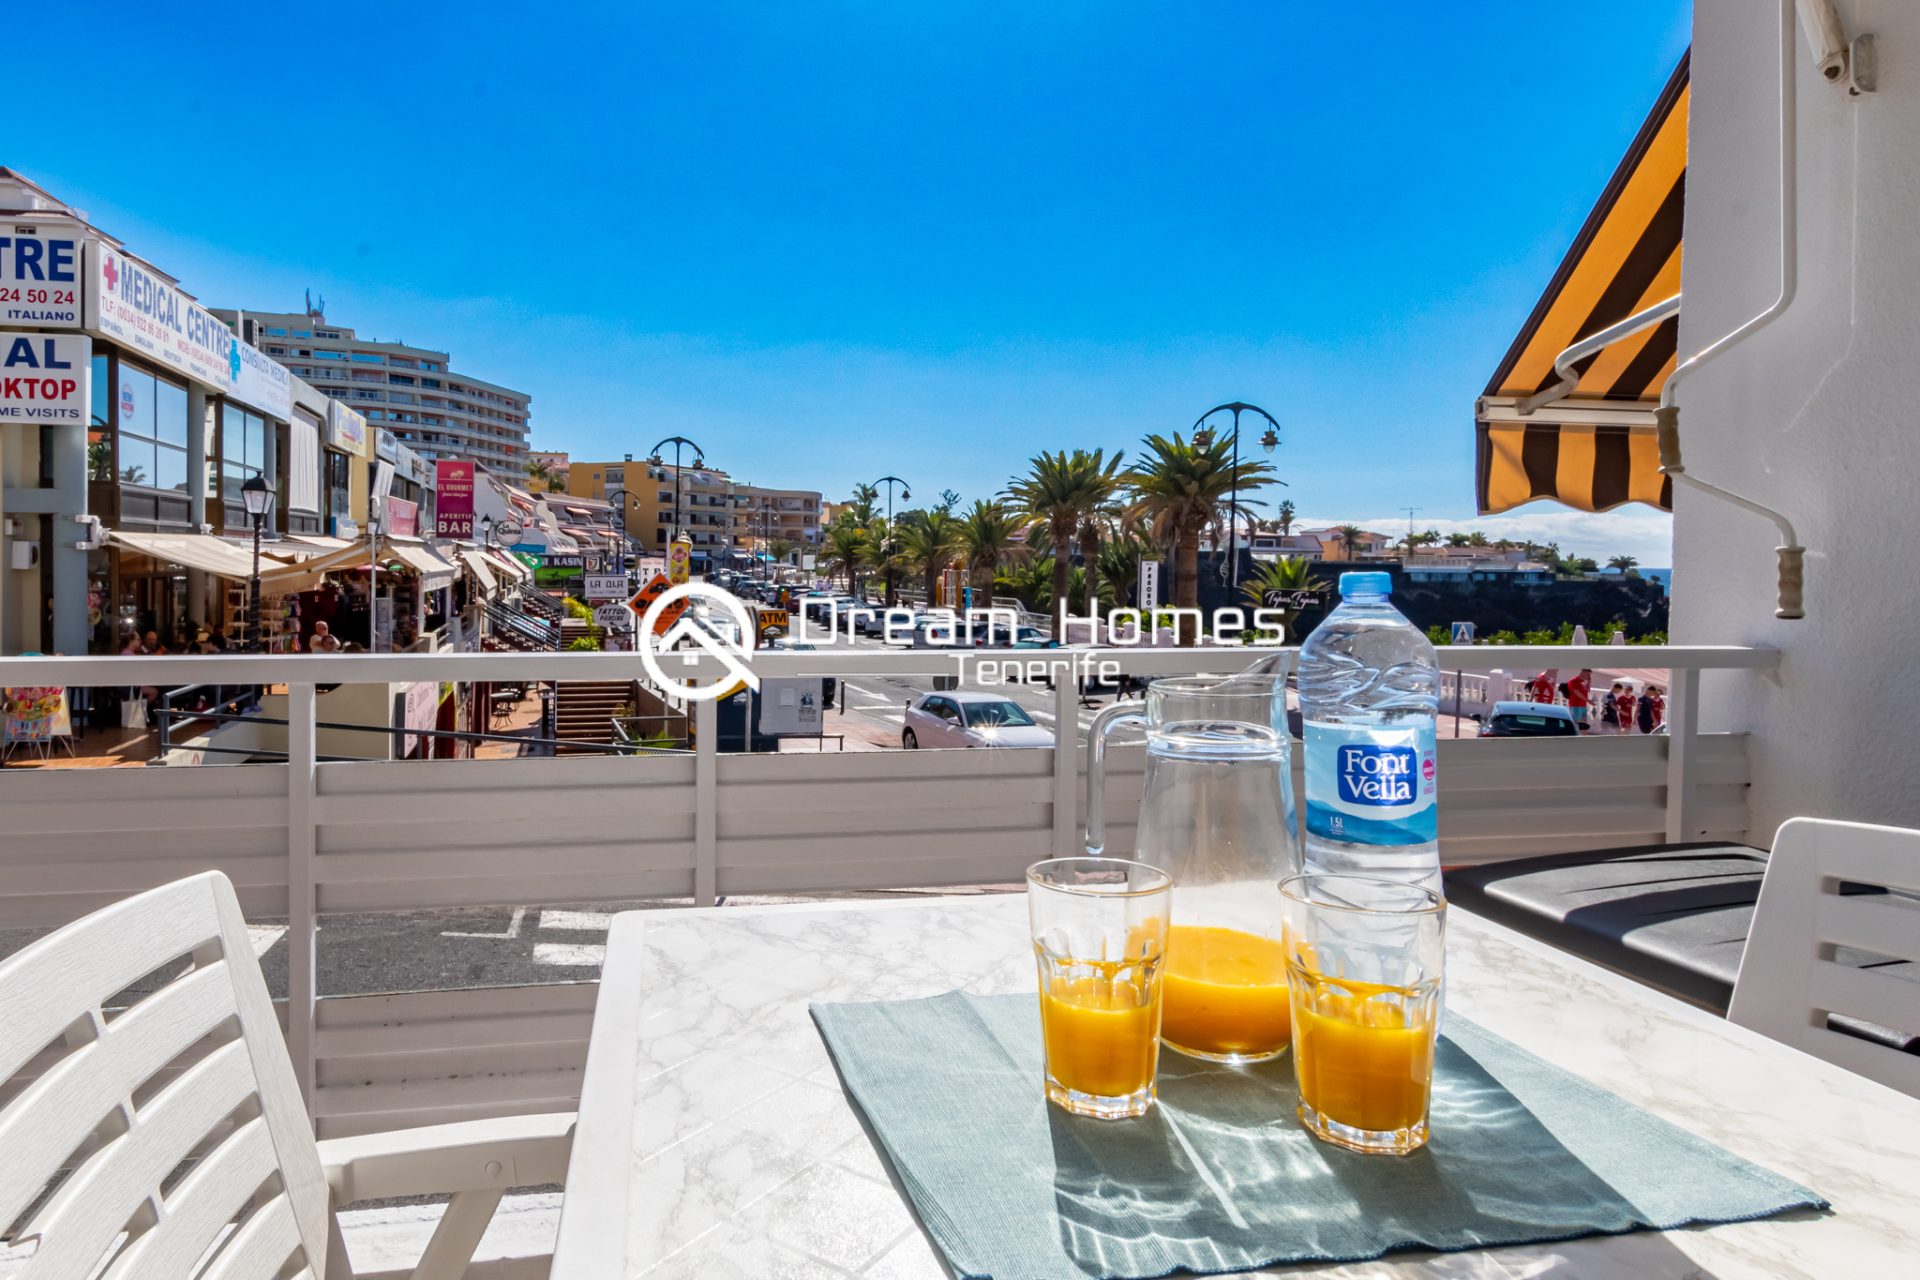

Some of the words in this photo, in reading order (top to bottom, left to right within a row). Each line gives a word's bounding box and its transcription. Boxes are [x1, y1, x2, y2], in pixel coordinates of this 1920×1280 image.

[0, 288, 20, 302] 24
[27, 289, 47, 303] 50
[54, 290, 75, 304] 24
[8, 310, 75, 321] ITALIANO
[121, 260, 182, 334] MEDICAL
[187, 305, 229, 361] CENTRE
[4, 337, 71, 369] AL
[0, 378, 76, 400] KTOP
[25, 408, 79, 418] VISITS
[438, 521, 471, 533] BAR
[590, 580, 601, 588] LA
[760, 612, 787, 623] ATM
[1345, 749, 1410, 774] Font
[1344, 774, 1412, 800] Vella
